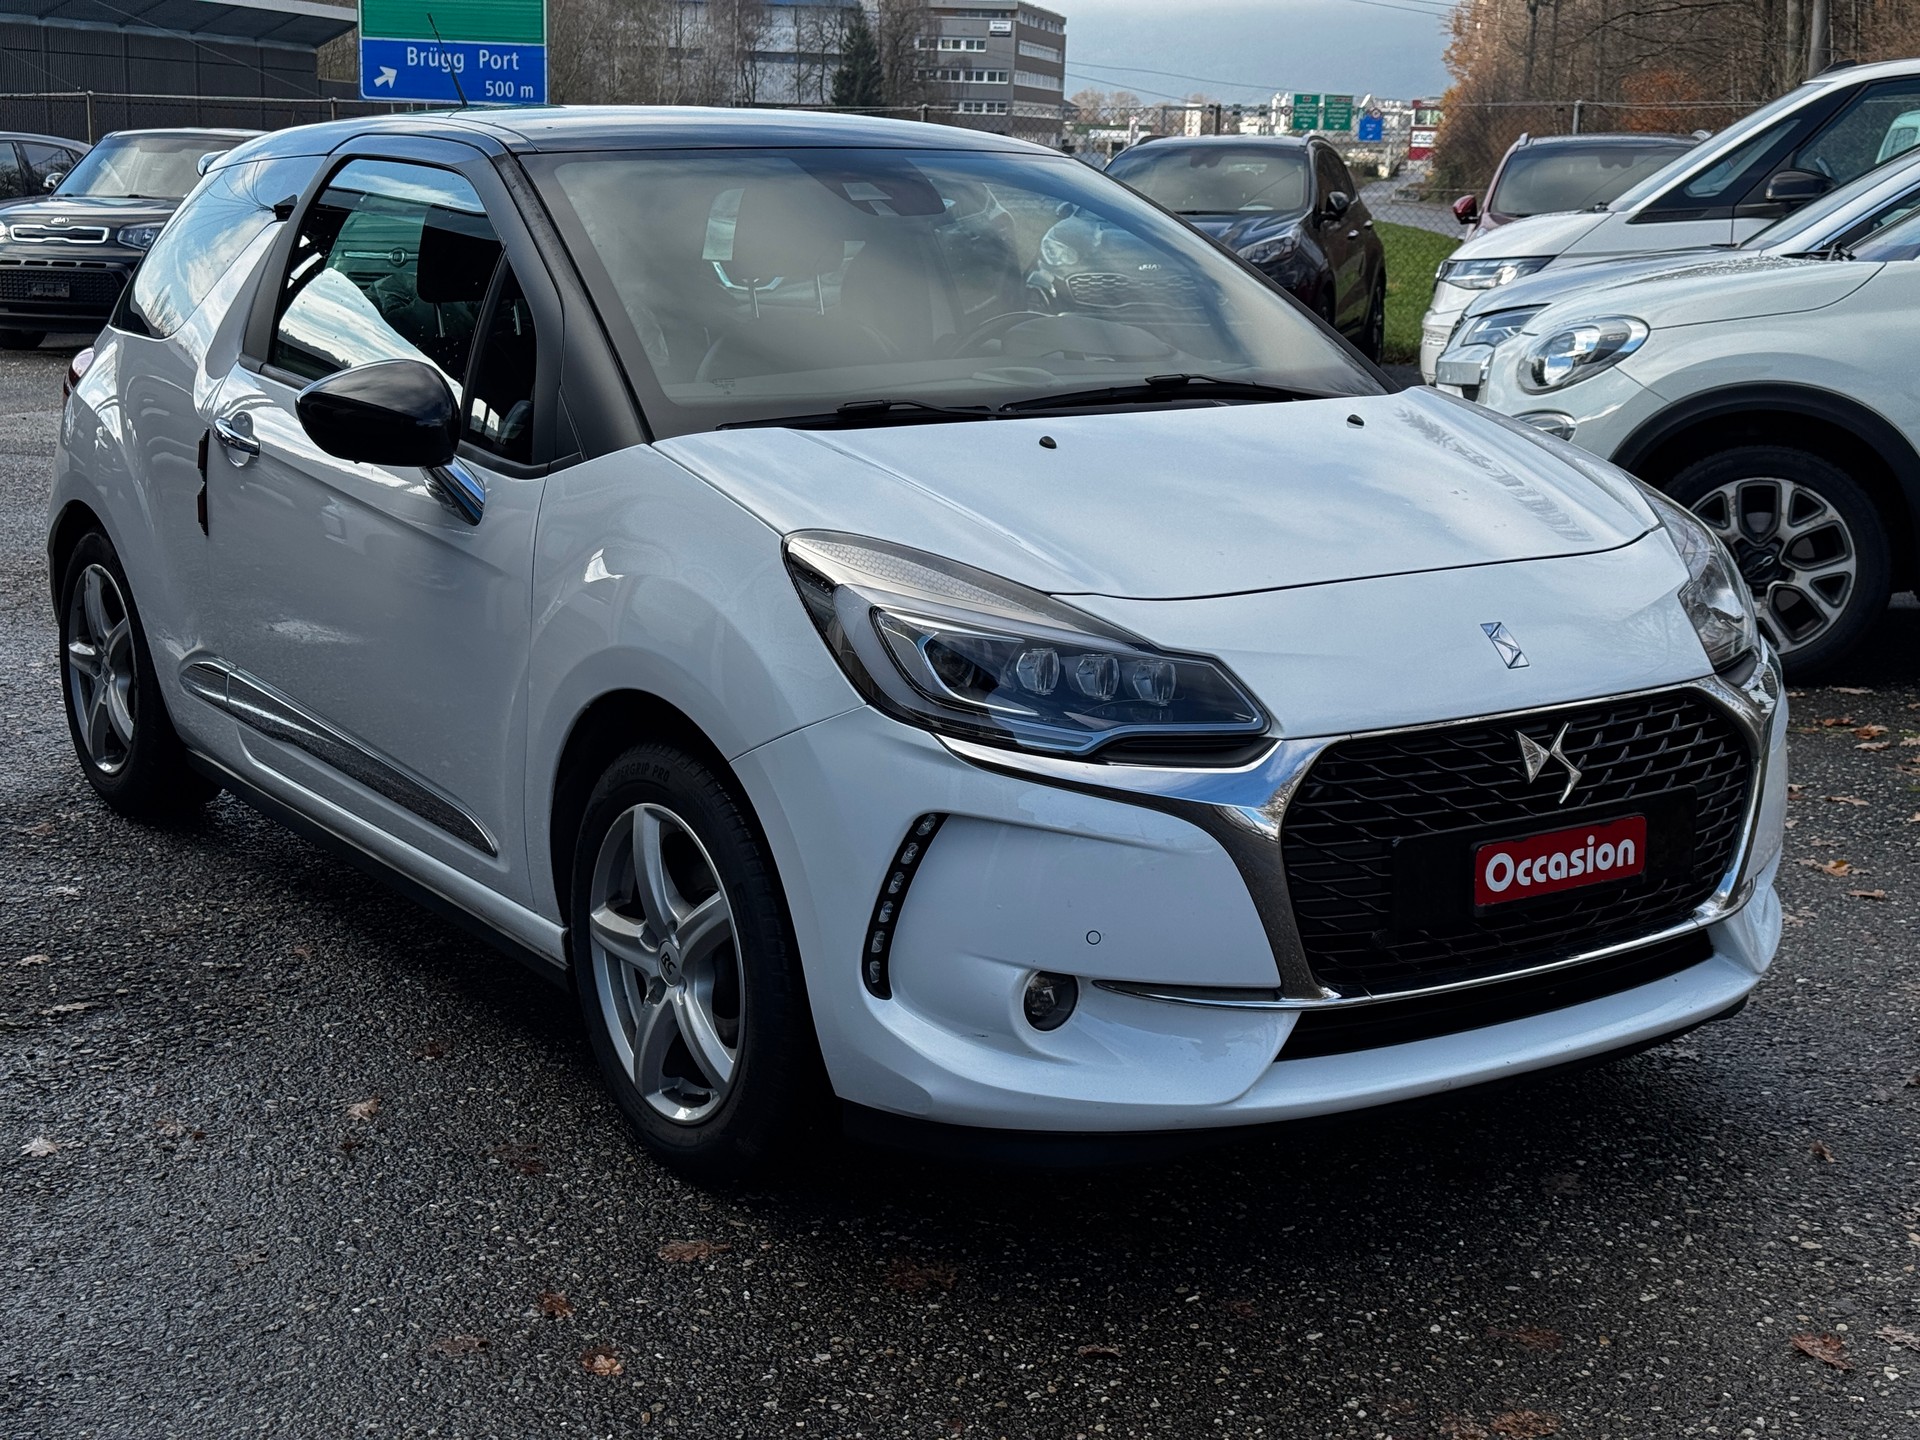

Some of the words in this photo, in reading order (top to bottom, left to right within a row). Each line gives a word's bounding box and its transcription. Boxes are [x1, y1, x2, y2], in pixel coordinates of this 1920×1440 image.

[407, 46, 465, 74] Brügg
[479, 49, 520, 71] Port
[485, 80, 515, 98] 500
[520, 85, 534, 99] m
[607, 762, 650, 786] SPERGRIP
[1485, 834, 1636, 893] Occasion
